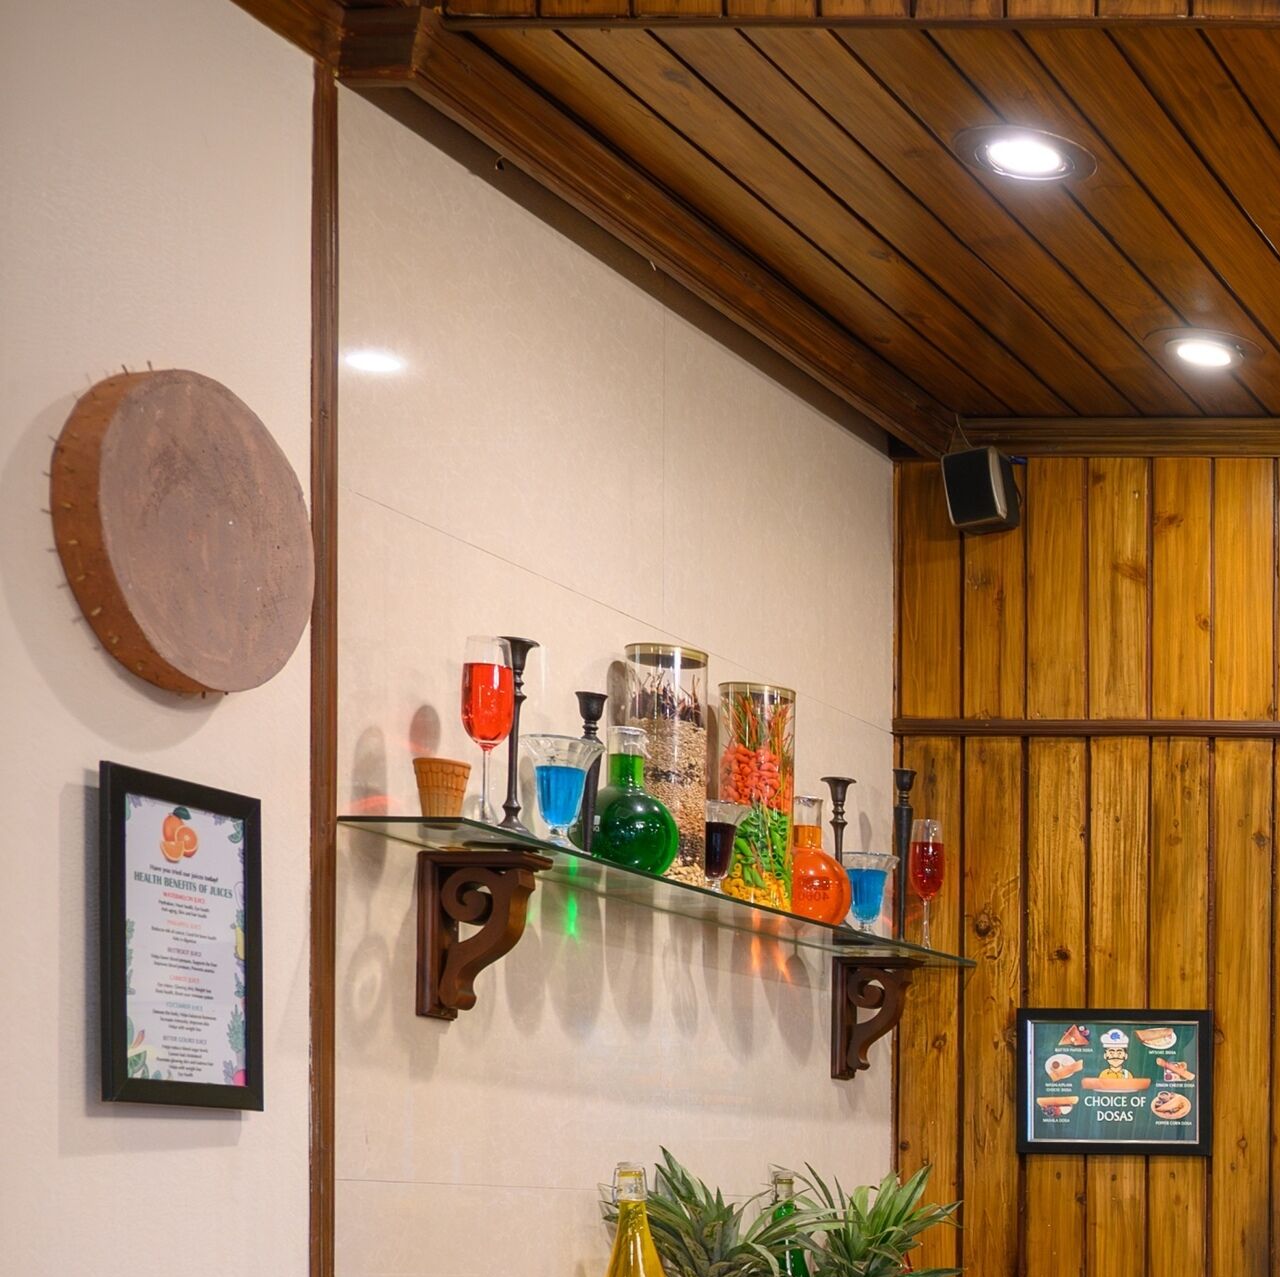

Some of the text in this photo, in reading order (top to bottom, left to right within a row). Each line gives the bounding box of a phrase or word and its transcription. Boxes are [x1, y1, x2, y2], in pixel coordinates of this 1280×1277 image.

[134, 871, 233, 898] HEALTH BENEFITS OF JUICES
[1084, 1096, 1146, 1107] CHOICE OF
[1097, 1111, 1133, 1121] DOSAS
